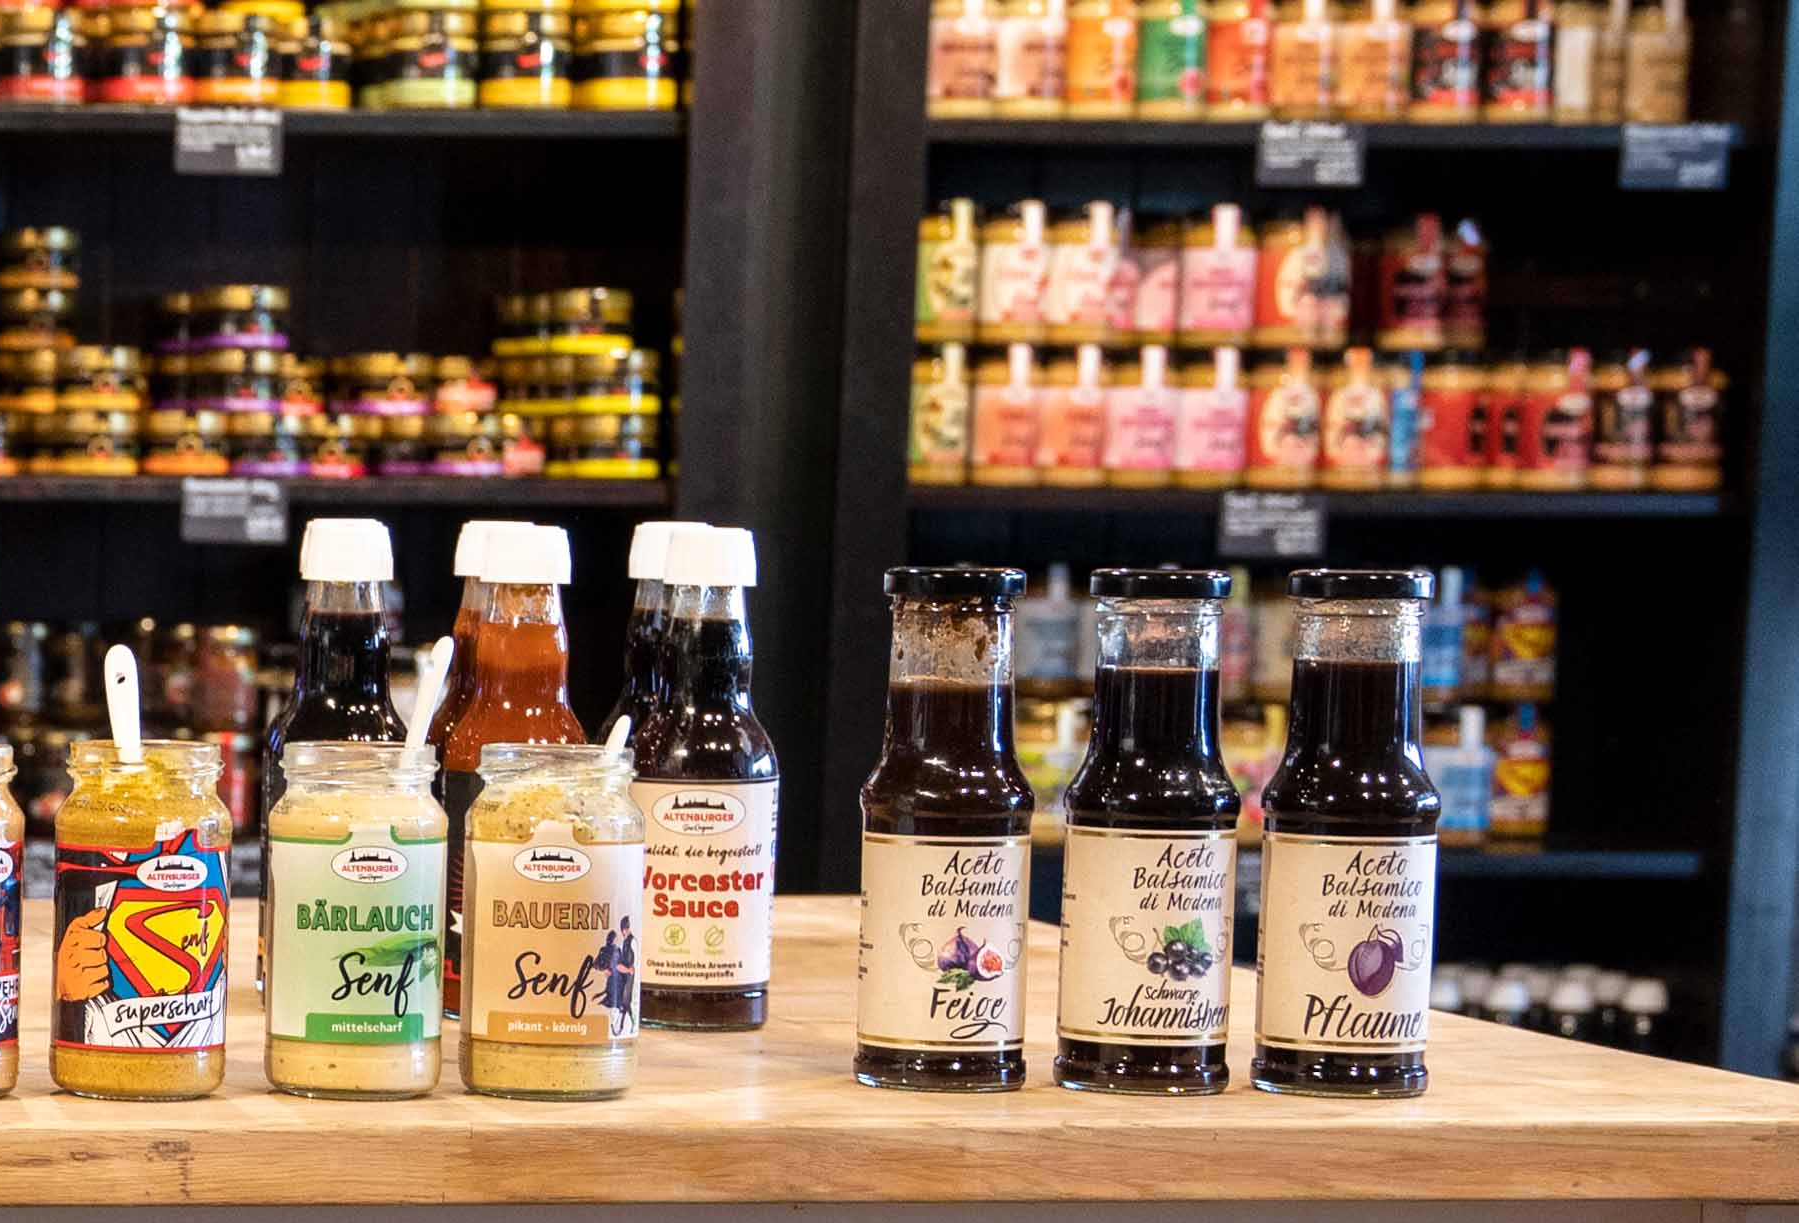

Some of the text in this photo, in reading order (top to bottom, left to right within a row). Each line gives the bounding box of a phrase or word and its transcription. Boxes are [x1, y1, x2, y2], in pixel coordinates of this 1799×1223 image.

[663, 812, 735, 822] ALTENBURGER
[685, 843, 704, 858] die
[1156, 843, 1215, 869] Aceto
[341, 864, 399, 873] ALTENBURGER
[523, 864, 582, 873] ALTENBURGER
[944, 850, 1005, 876] Aceto
[1345, 850, 1409, 876] Aceto
[146, 872, 201, 881] ALTENBURGER
[921, 874, 1019, 897] Balsamico
[1133, 866, 1226, 890] Balsamico
[1322, 873, 1423, 897] Balsamico
[653, 892, 740, 919] Sauce
[927, 899, 1015, 918] di Modena
[1139, 892, 1223, 911] di Modena
[1328, 899, 1418, 919] di Modena
[296, 899, 434, 932] BÄRLAUCH
[492, 900, 610, 931] BAUERN
[331, 951, 415, 1019] Senf
[507, 951, 594, 1019] Senf
[1144, 978, 1201, 1004] Schwarze
[930, 986, 1009, 1040] Feige
[1303, 993, 1424, 1040] Pflaume
[331, 1021, 403, 1033] mittelscharf
[508, 1021, 587, 1036] pikant körnig
